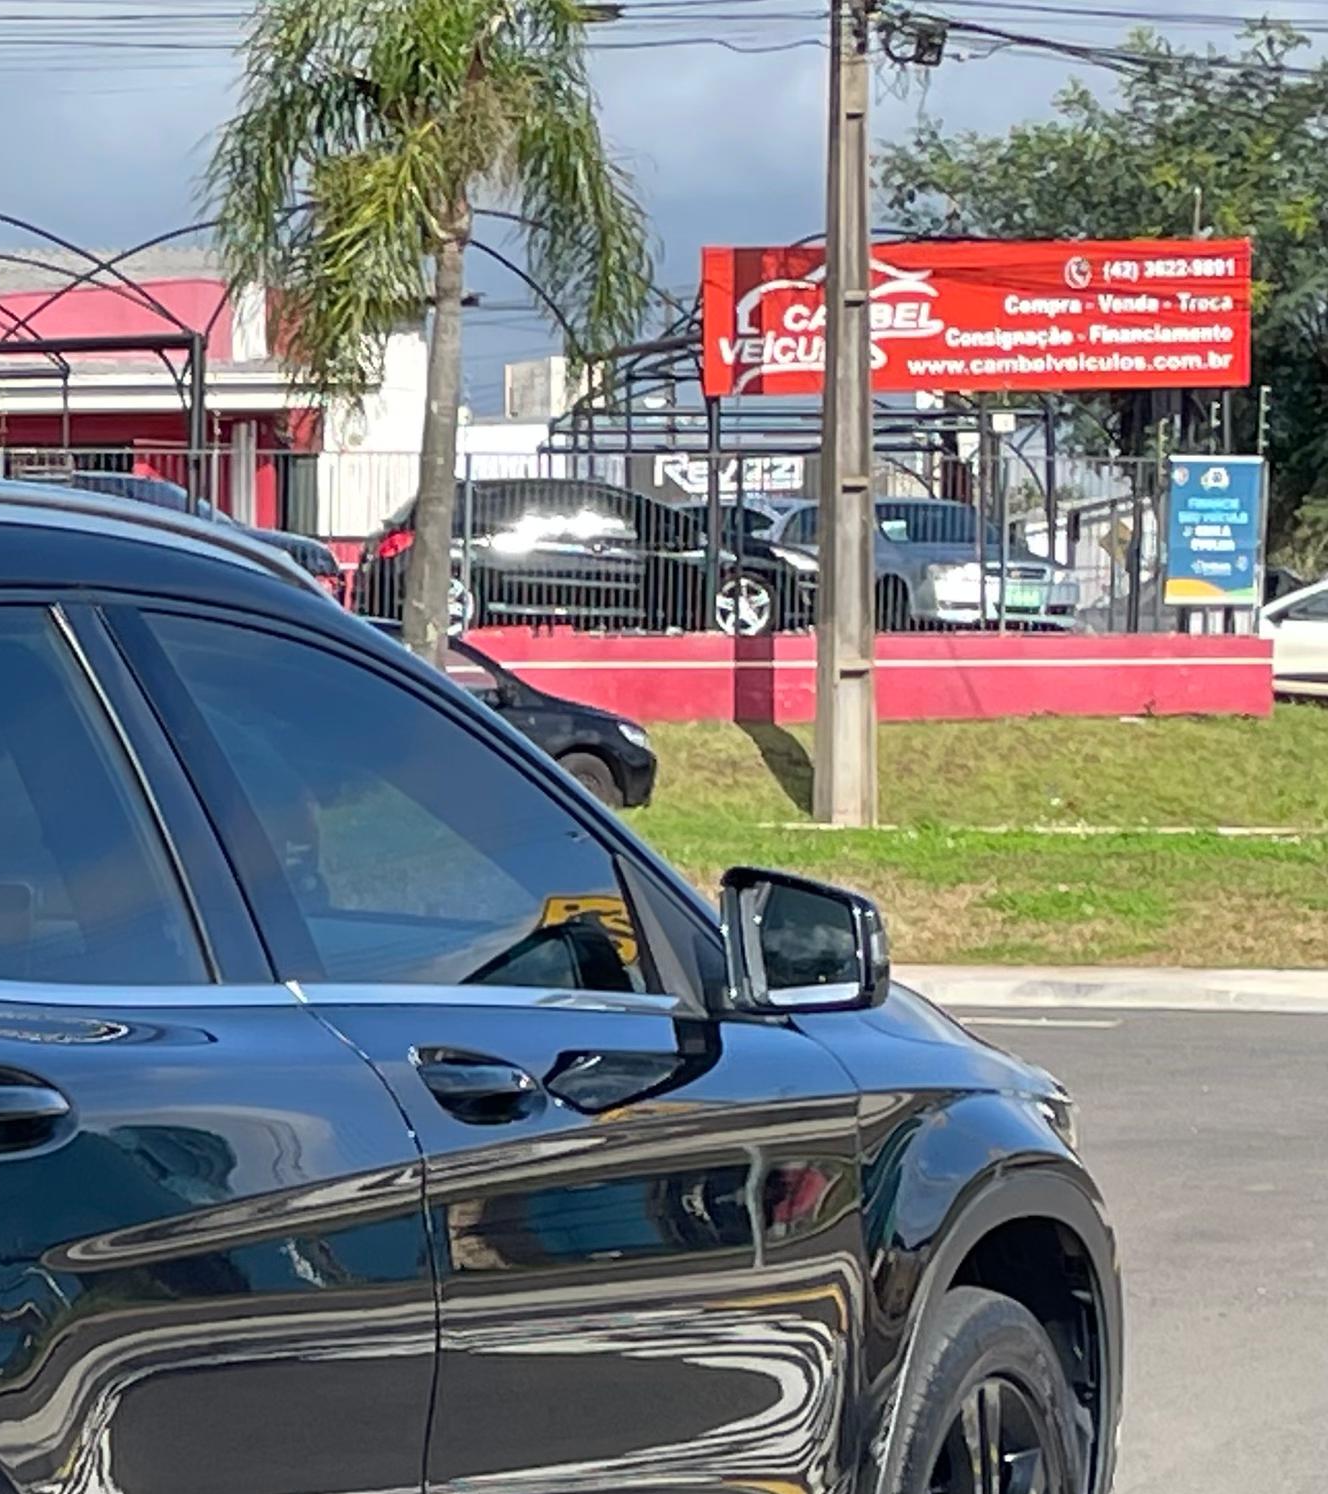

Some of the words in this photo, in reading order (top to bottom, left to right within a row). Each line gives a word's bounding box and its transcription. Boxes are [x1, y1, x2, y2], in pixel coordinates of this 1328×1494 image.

[784, 302, 943, 333] CABEL
[1004, 293, 1082, 318] Compra
[1097, 293, 1160, 314] Venda
[1175, 291, 1234, 312] Troca
[719, 331, 888, 368] VEÍCUS
[945, 326, 1074, 351] Consignação
[1089, 322, 1234, 345] Financiamento
